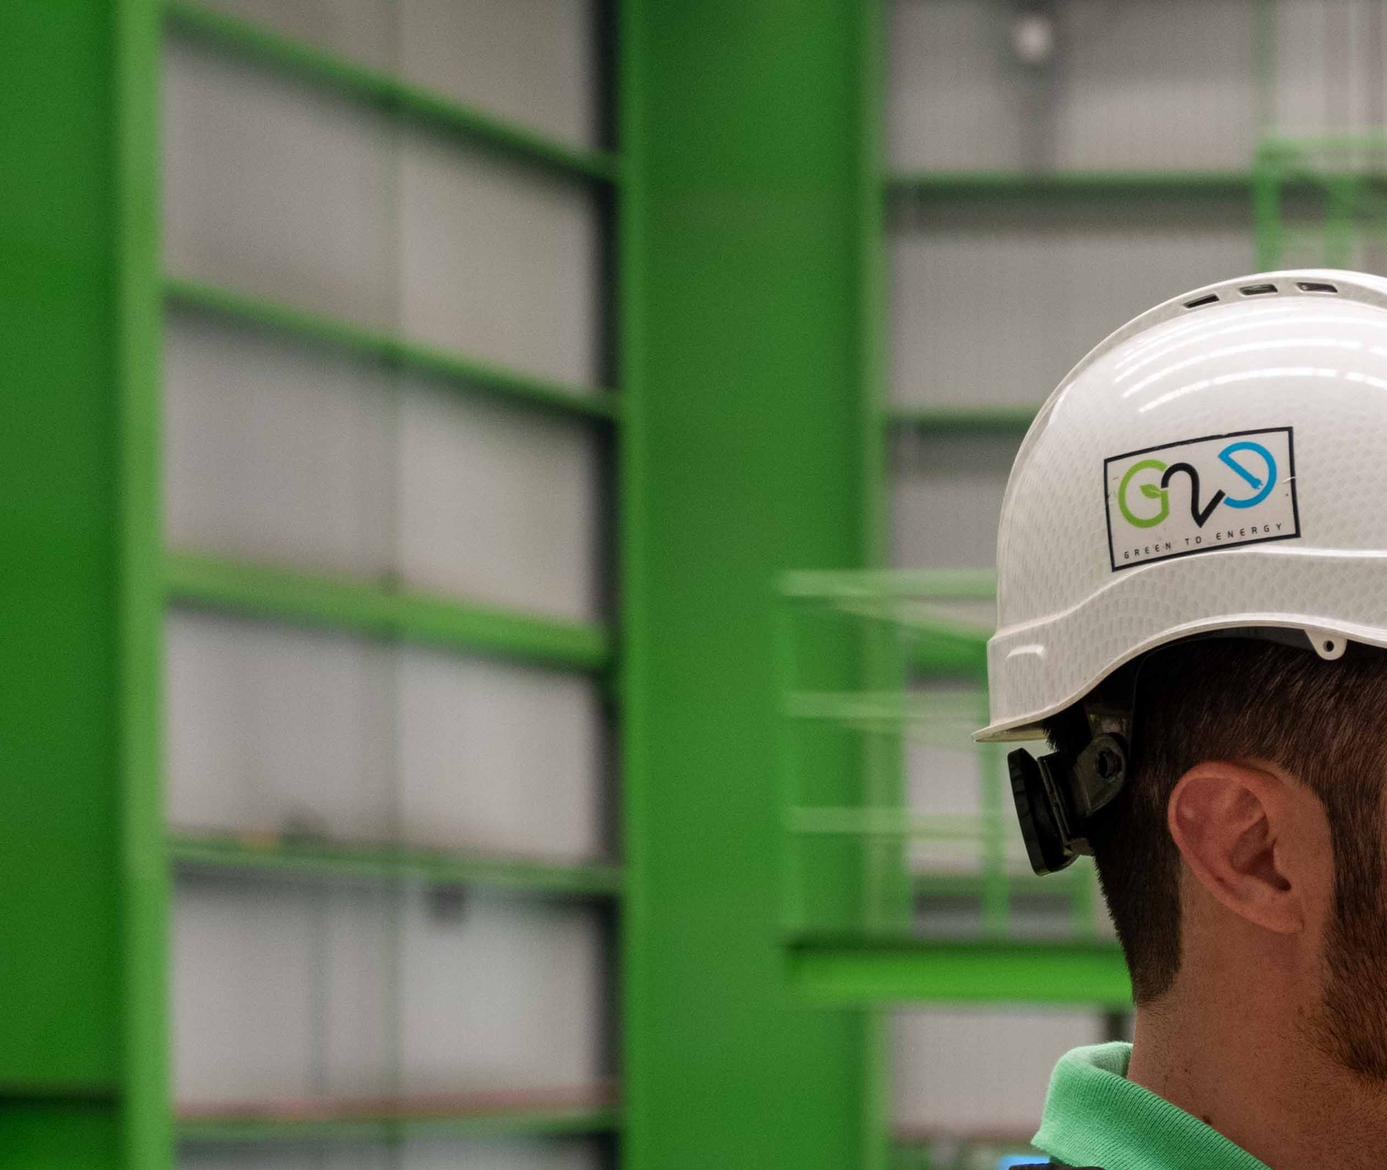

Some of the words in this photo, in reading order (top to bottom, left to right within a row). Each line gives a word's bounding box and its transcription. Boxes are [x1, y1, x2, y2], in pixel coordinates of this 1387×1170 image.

[1124, 542, 1171, 559] GREEN
[1185, 536, 1202, 546] TO
[1216, 523, 1282, 540] ENERGY
